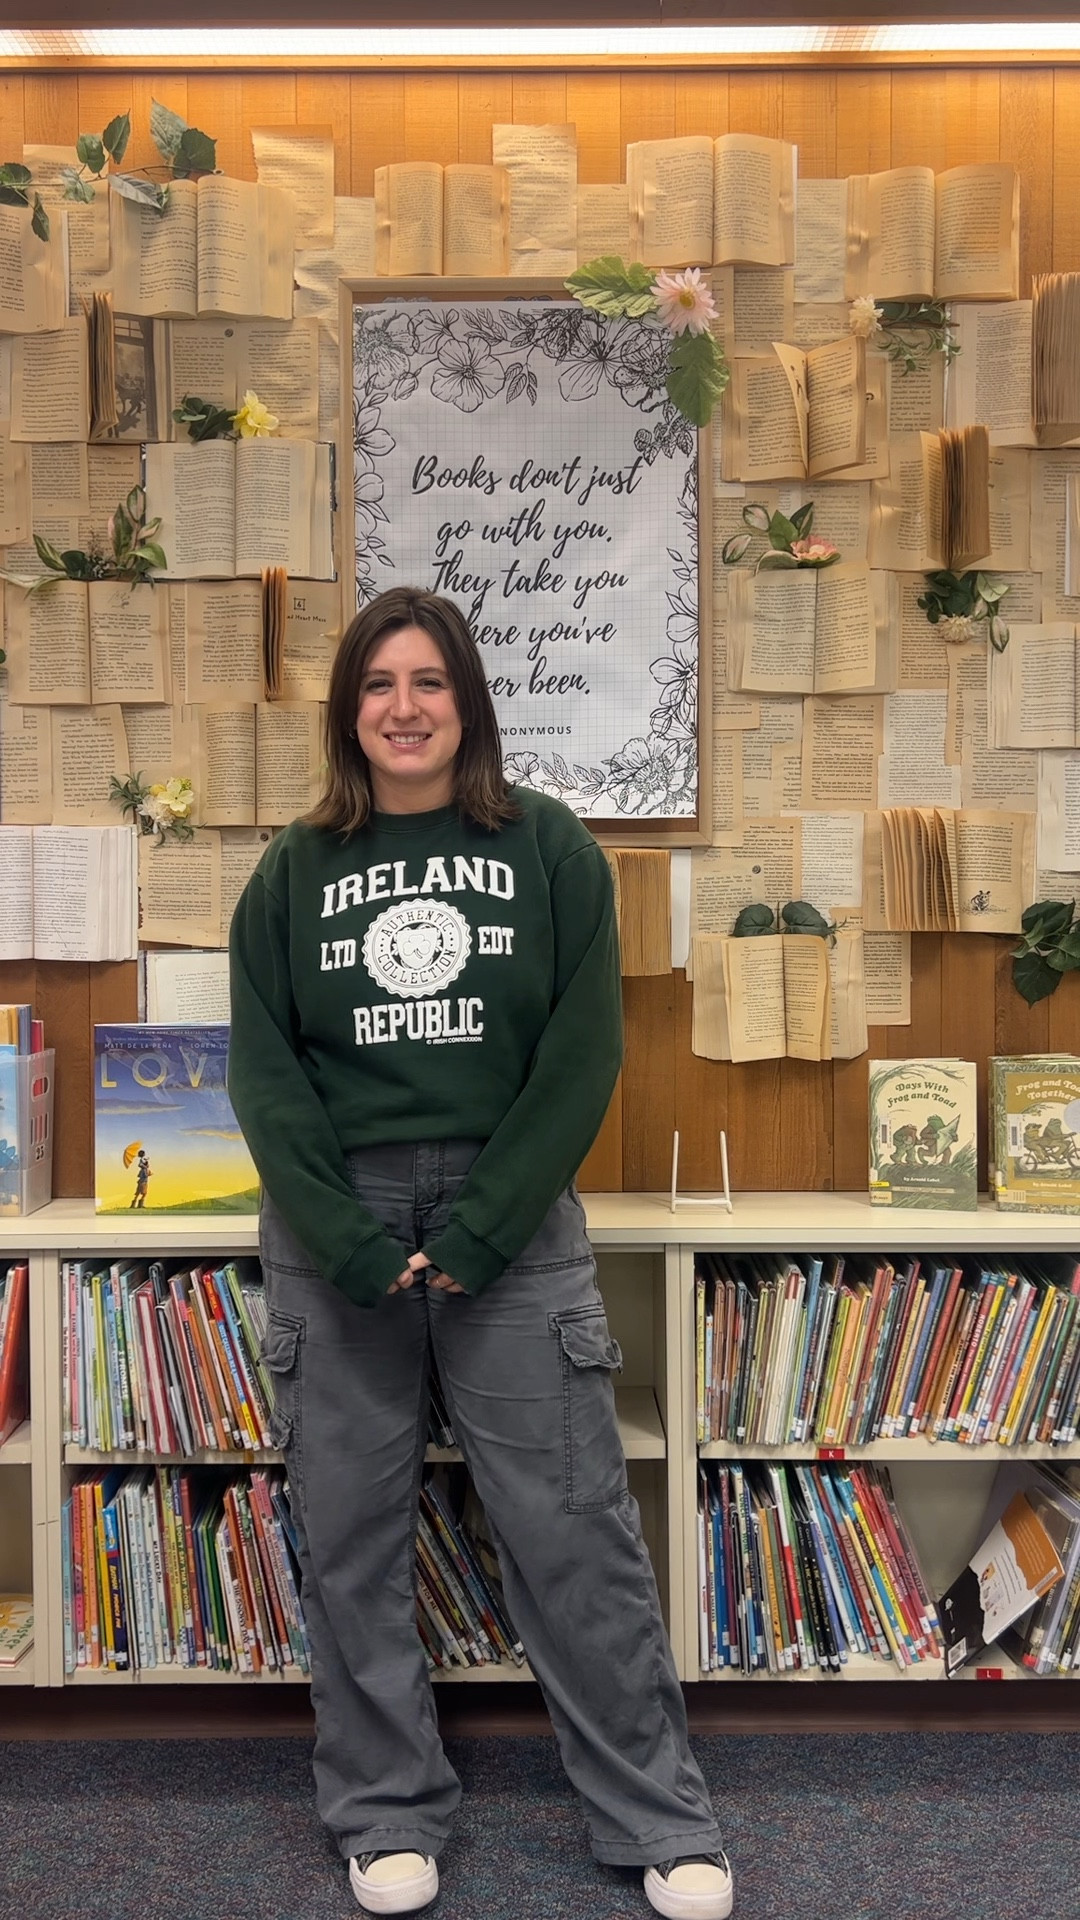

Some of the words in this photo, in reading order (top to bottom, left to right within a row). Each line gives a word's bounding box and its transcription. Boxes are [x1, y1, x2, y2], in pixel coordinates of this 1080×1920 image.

[411, 455, 501, 496] Books
[509, 459, 580, 493] don't
[579, 456, 644, 506] just
[435, 520, 473, 557] go
[482, 498, 546, 544] with
[552, 523, 612, 558] you.
[427, 549, 495, 609] They
[500, 551, 566, 596] take
[574, 575, 628, 609] you
[466, 604, 521, 647] here
[528, 619, 617, 660] you've
[528, 656, 591, 698] been.
[499, 726, 572, 736] NONYMOUS
[320, 855, 515, 918] IRELAND
[380, 910, 455, 938] AUTHENTIC
[320, 938, 357, 972] LTD
[477, 925, 514, 955] EDT
[377, 948, 457, 985] COLLECTION
[353, 997, 484, 1045] REPUBLIC
[100, 1051, 228, 1088] LOV
[887, 1093, 910, 1108] Frog
[911, 1092, 930, 1100] and
[931, 1092, 957, 1109] Toad
[895, 1081, 922, 1093] Days
[923, 1081, 950, 1094] With
[1015, 1080, 1041, 1096] Frog
[1042, 1079, 1062, 1087] and
[1027, 1090, 1076, 1101] Together
[970, 1313, 985, 1348] ROBERTO
[118, 1356, 128, 1399] PROMISE
[828, 1449, 834, 1459] K
[152, 1540, 157, 1549] MY
[823, 1533, 832, 1548] I'm
[109, 1564, 118, 1590] BATMAN
[235, 1599, 246, 1627] SNOWY
[986, 1670, 992, 1678] L
